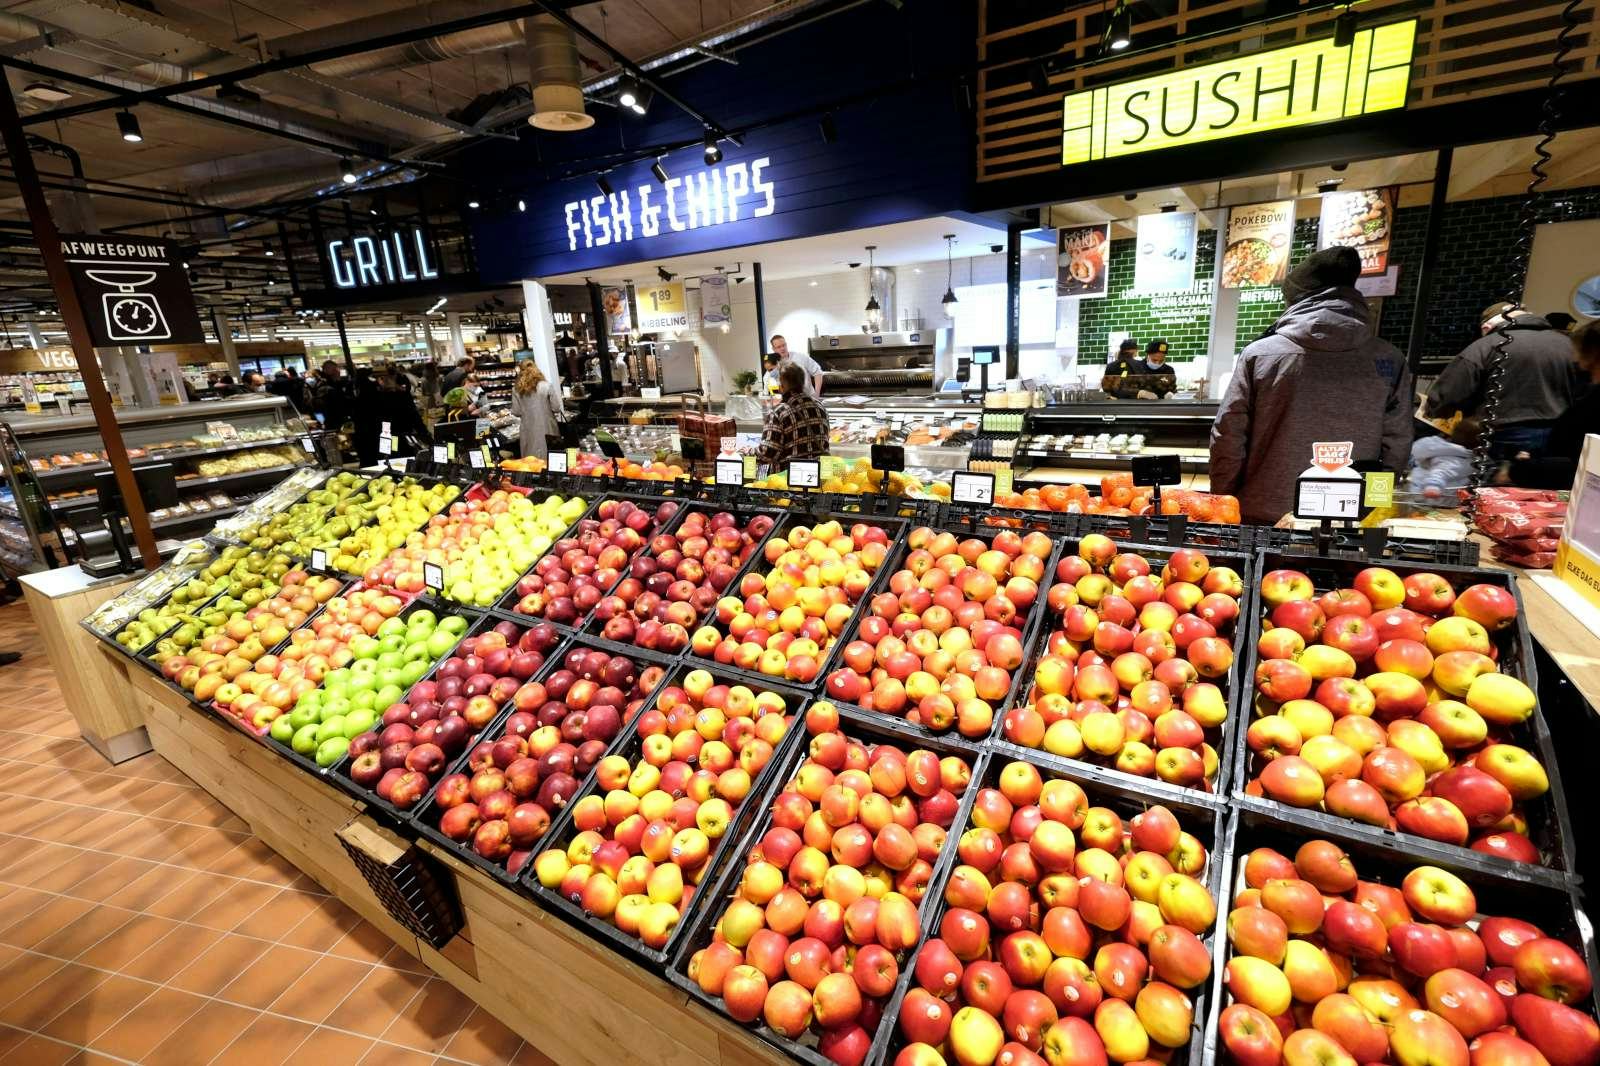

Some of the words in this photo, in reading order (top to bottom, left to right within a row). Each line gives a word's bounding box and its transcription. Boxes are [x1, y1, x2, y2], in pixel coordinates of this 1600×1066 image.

[1122, 54, 1323, 145] SUSHI
[565, 190, 633, 251] FISH
[638, 184, 662, 238] &
[665, 157, 775, 232] CHIPS
[60, 241, 166, 258] AFWEEGPUNT
[329, 229, 438, 287] GRILL
[37, 351, 78, 368] VEG
[1566, 561, 1582, 577] ELKE
[1581, 571, 1594, 586] DAG
